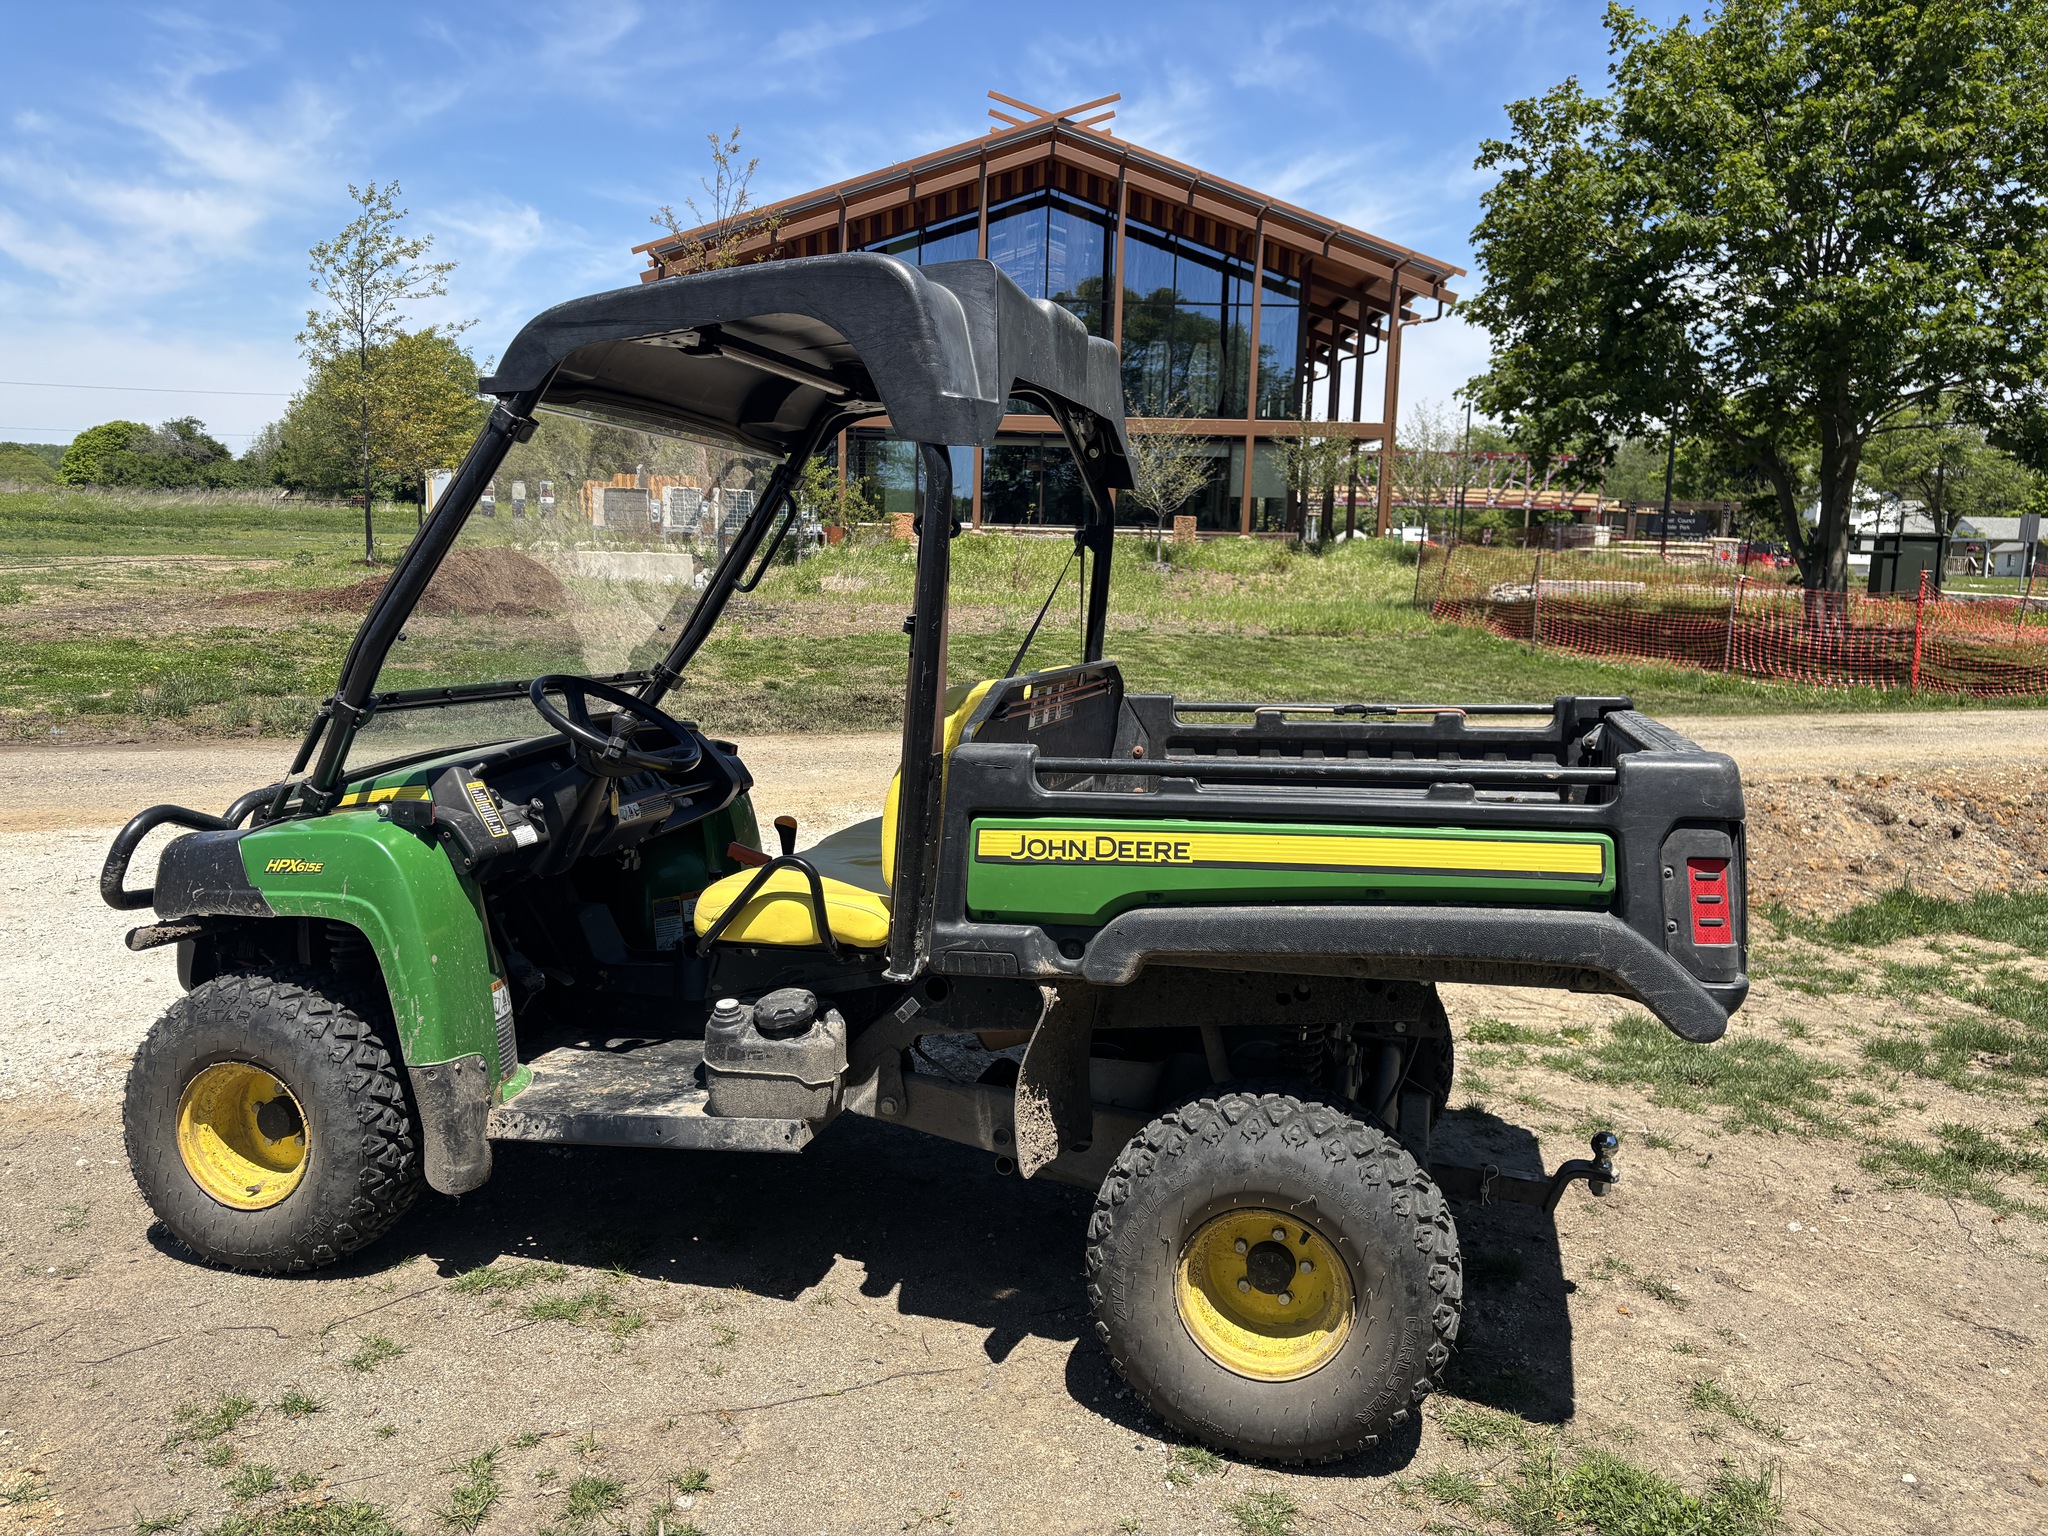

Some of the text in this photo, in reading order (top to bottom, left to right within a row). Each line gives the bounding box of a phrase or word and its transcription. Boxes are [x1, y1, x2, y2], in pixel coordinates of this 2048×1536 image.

[264, 859, 324, 872] HPX615E
[1011, 835, 1191, 860] JOHN DEERE
[1116, 1186, 1168, 1256] TRAIL
[1112, 1267, 1127, 1321] ALL
[1355, 1316, 1418, 1424] CARLSTAR
